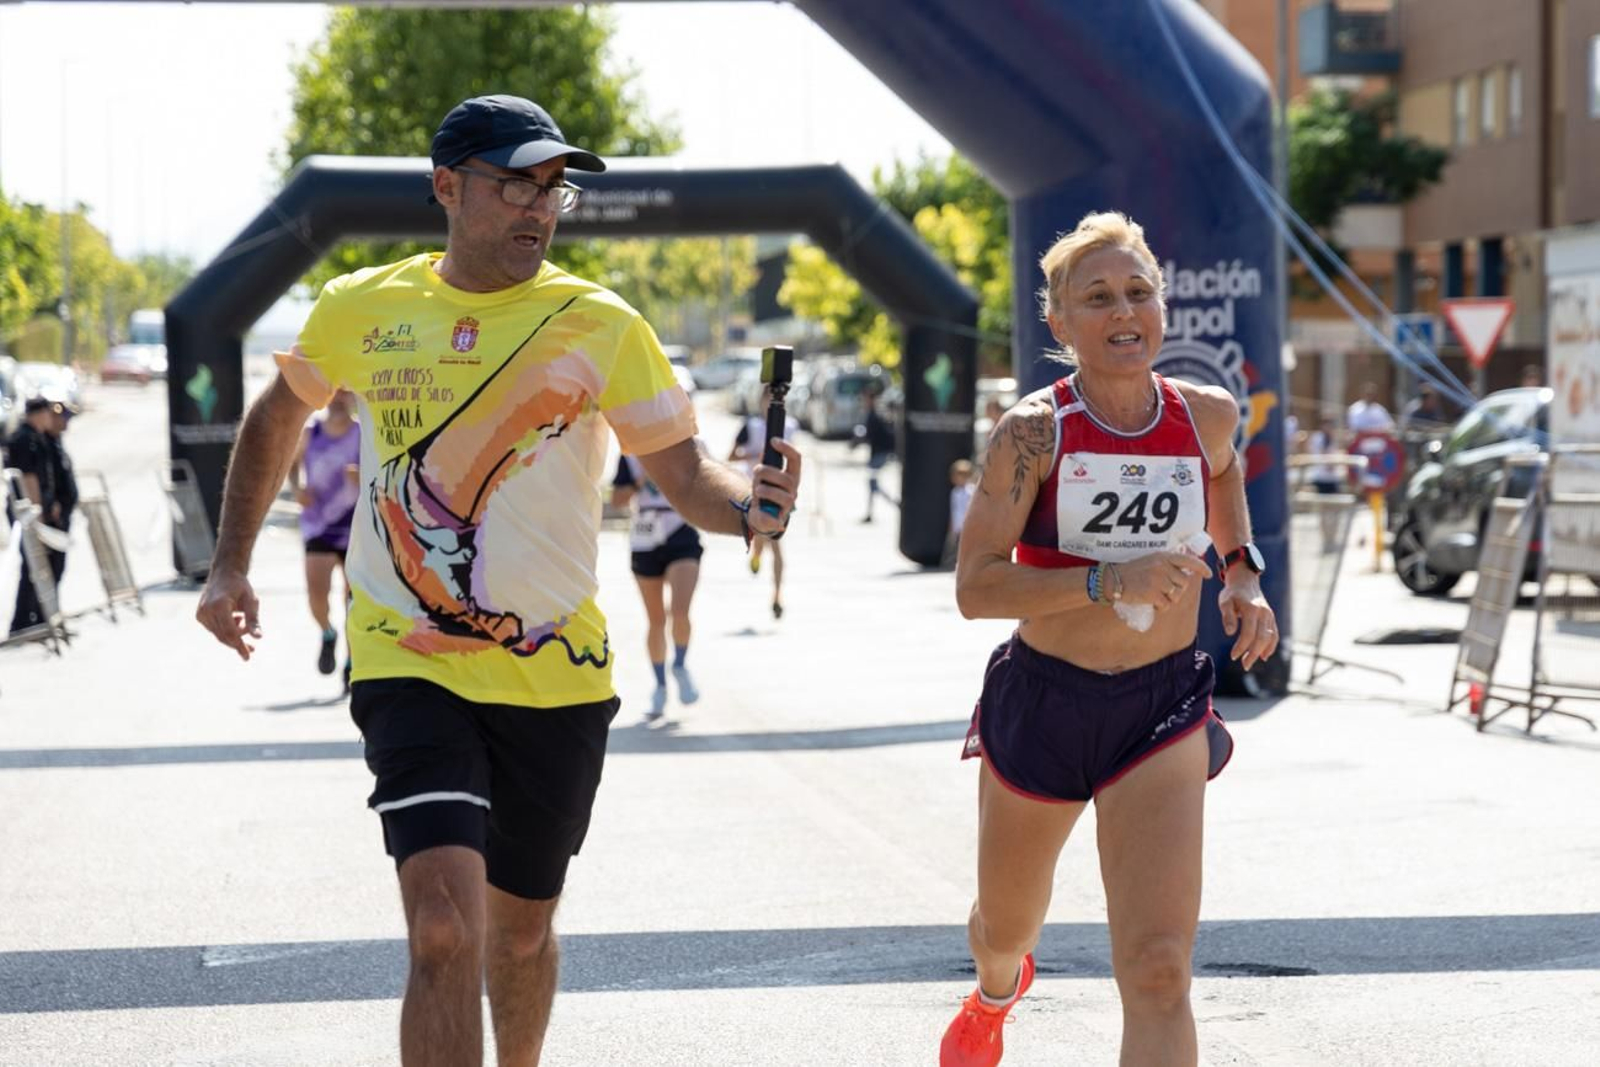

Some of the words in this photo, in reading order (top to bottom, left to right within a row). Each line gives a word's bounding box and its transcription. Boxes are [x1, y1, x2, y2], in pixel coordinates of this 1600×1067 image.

[397, 368, 433, 385] CROSS
[411, 387, 420, 400] DE
[426, 387, 454, 402] SILOS
[382, 404, 423, 428] ALCALÁ
[1082, 491, 1179, 534] 249
